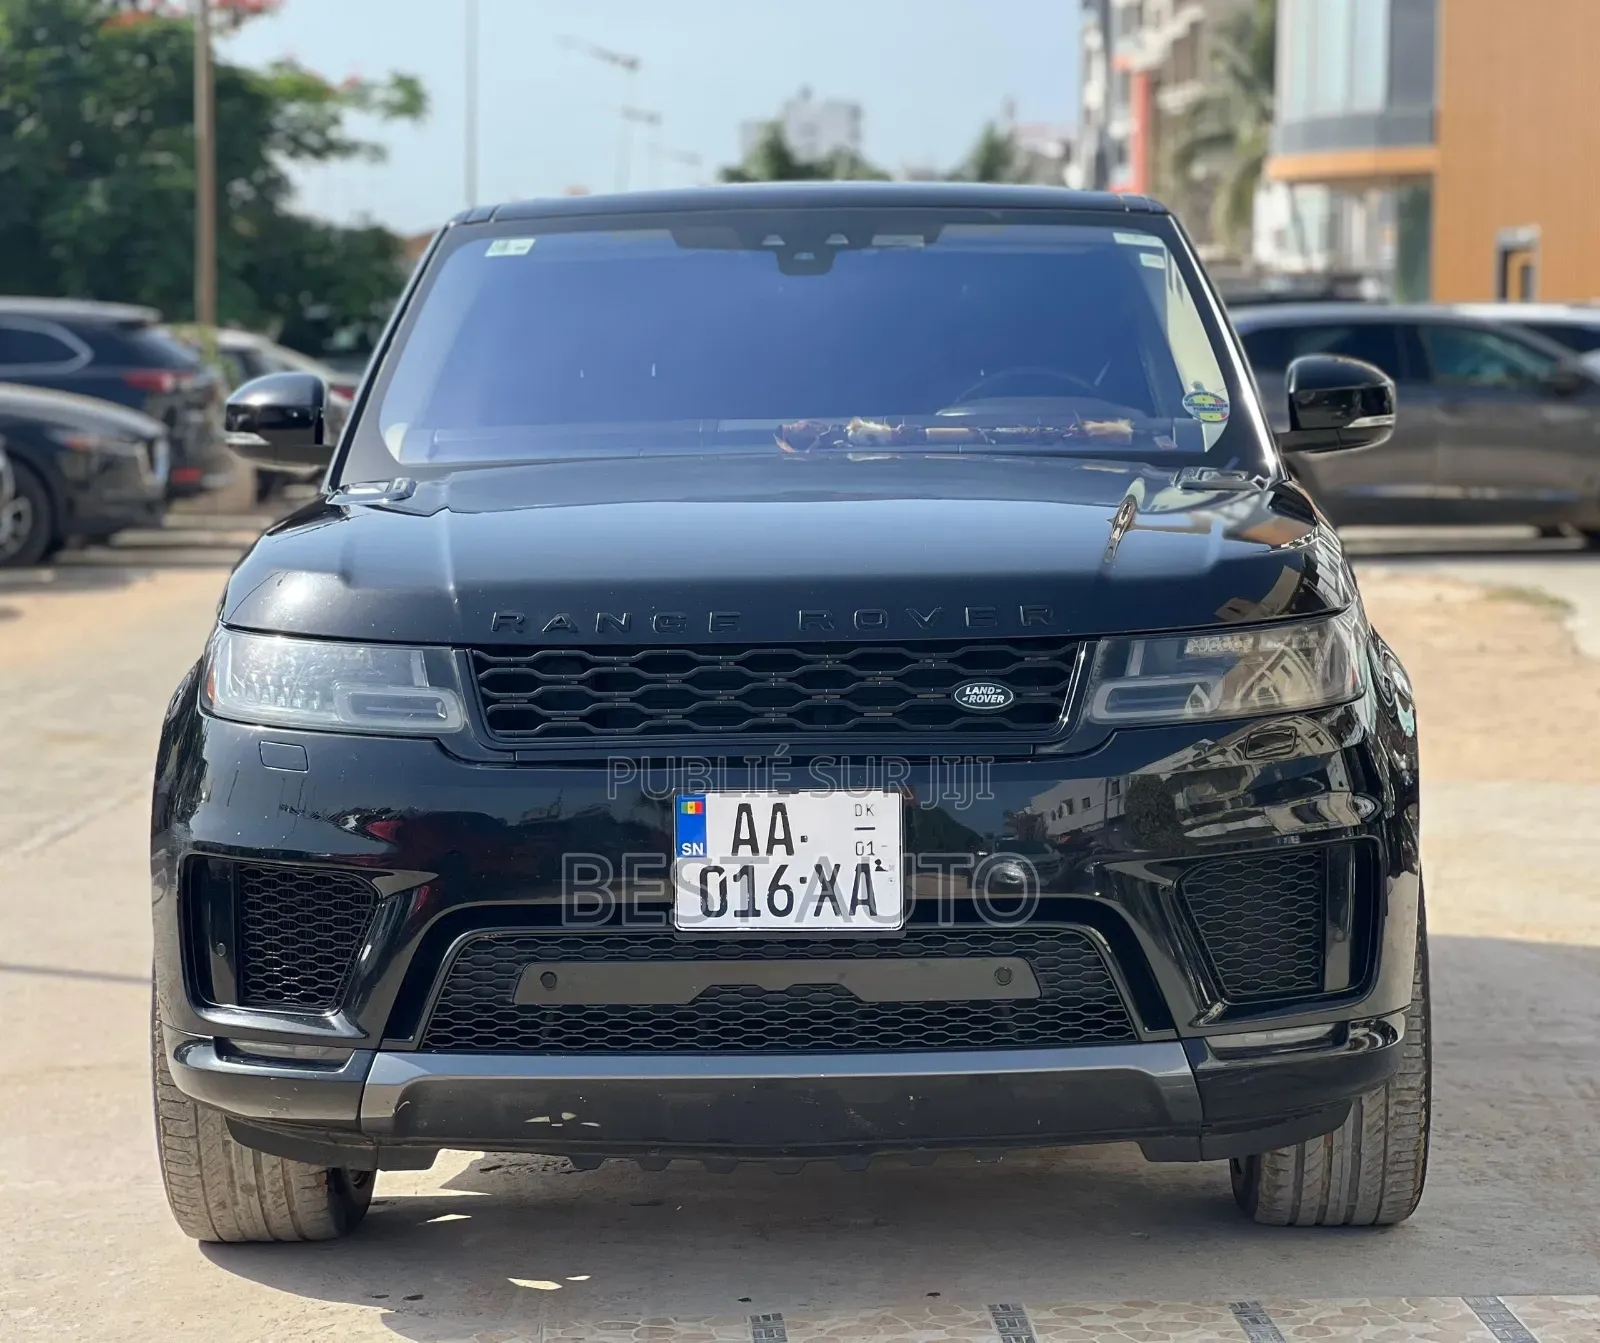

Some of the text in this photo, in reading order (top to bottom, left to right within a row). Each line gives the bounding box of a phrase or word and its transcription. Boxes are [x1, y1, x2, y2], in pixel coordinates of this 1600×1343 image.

[491, 605, 1054, 633] RANGE ROVER
[965, 686, 995, 695] LAND
[968, 695, 1005, 703] ROVER
[854, 803, 875, 817] DK
[731, 803, 795, 856] AA
[681, 842, 704, 856] SN
[855, 841, 875, 856] 01
